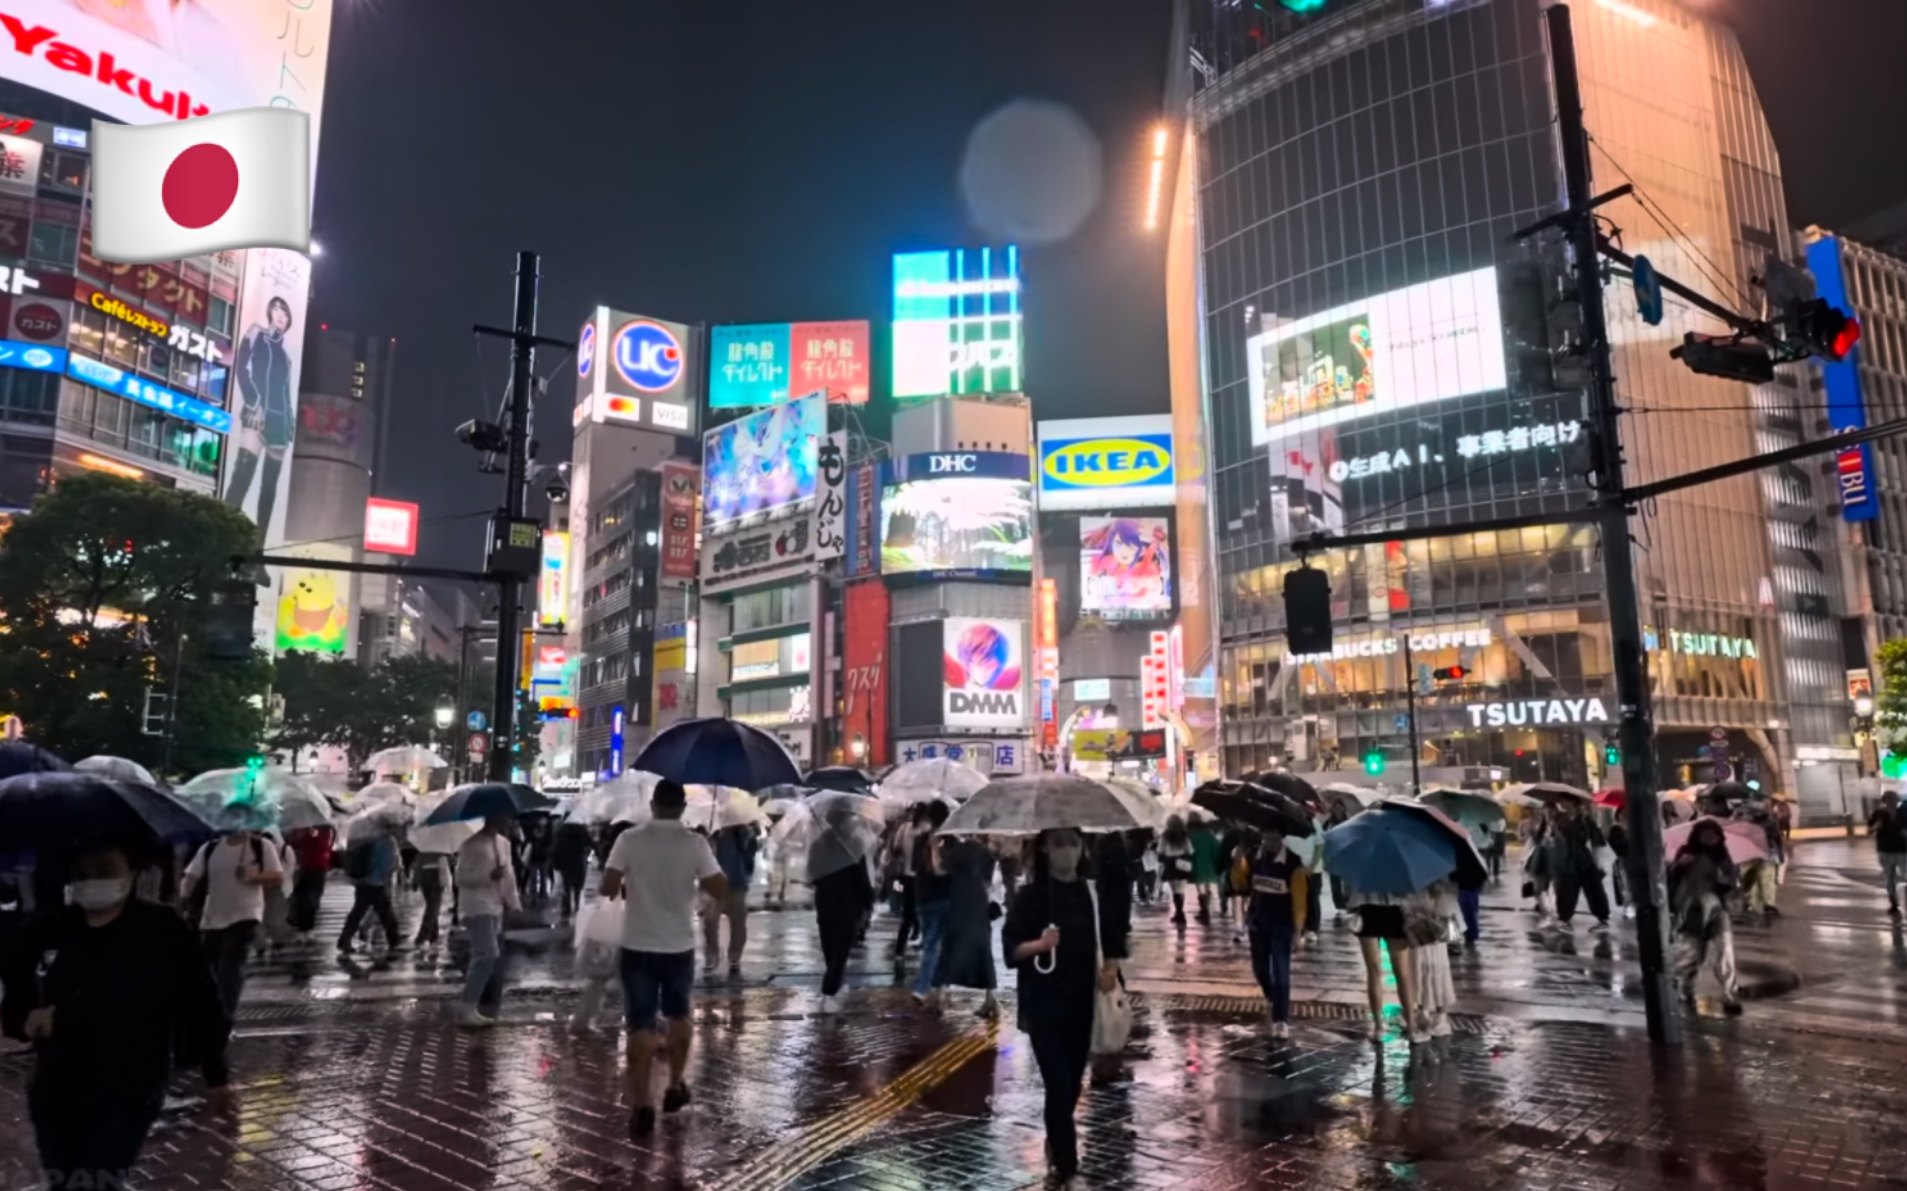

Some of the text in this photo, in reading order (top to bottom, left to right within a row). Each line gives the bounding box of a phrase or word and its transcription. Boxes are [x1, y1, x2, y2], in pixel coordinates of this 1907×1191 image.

[20, 317, 58, 332] ガスト
[168, 324, 223, 362] ガスト
[656, 408, 686, 422] VISA
[929, 454, 977, 473] DHC
[1055, 450, 1162, 473] IKEA
[1833, 424, 1867, 505] IBU
[817, 437, 847, 554] もんじゃ
[1408, 629, 1491, 651] COFFEE
[1670, 628, 1760, 659] TSUTAYA
[949, 692, 1017, 716] DMM
[1467, 698, 1608, 727] TSUTAYA
[903, 744, 1015, 766] 大盛堂店
